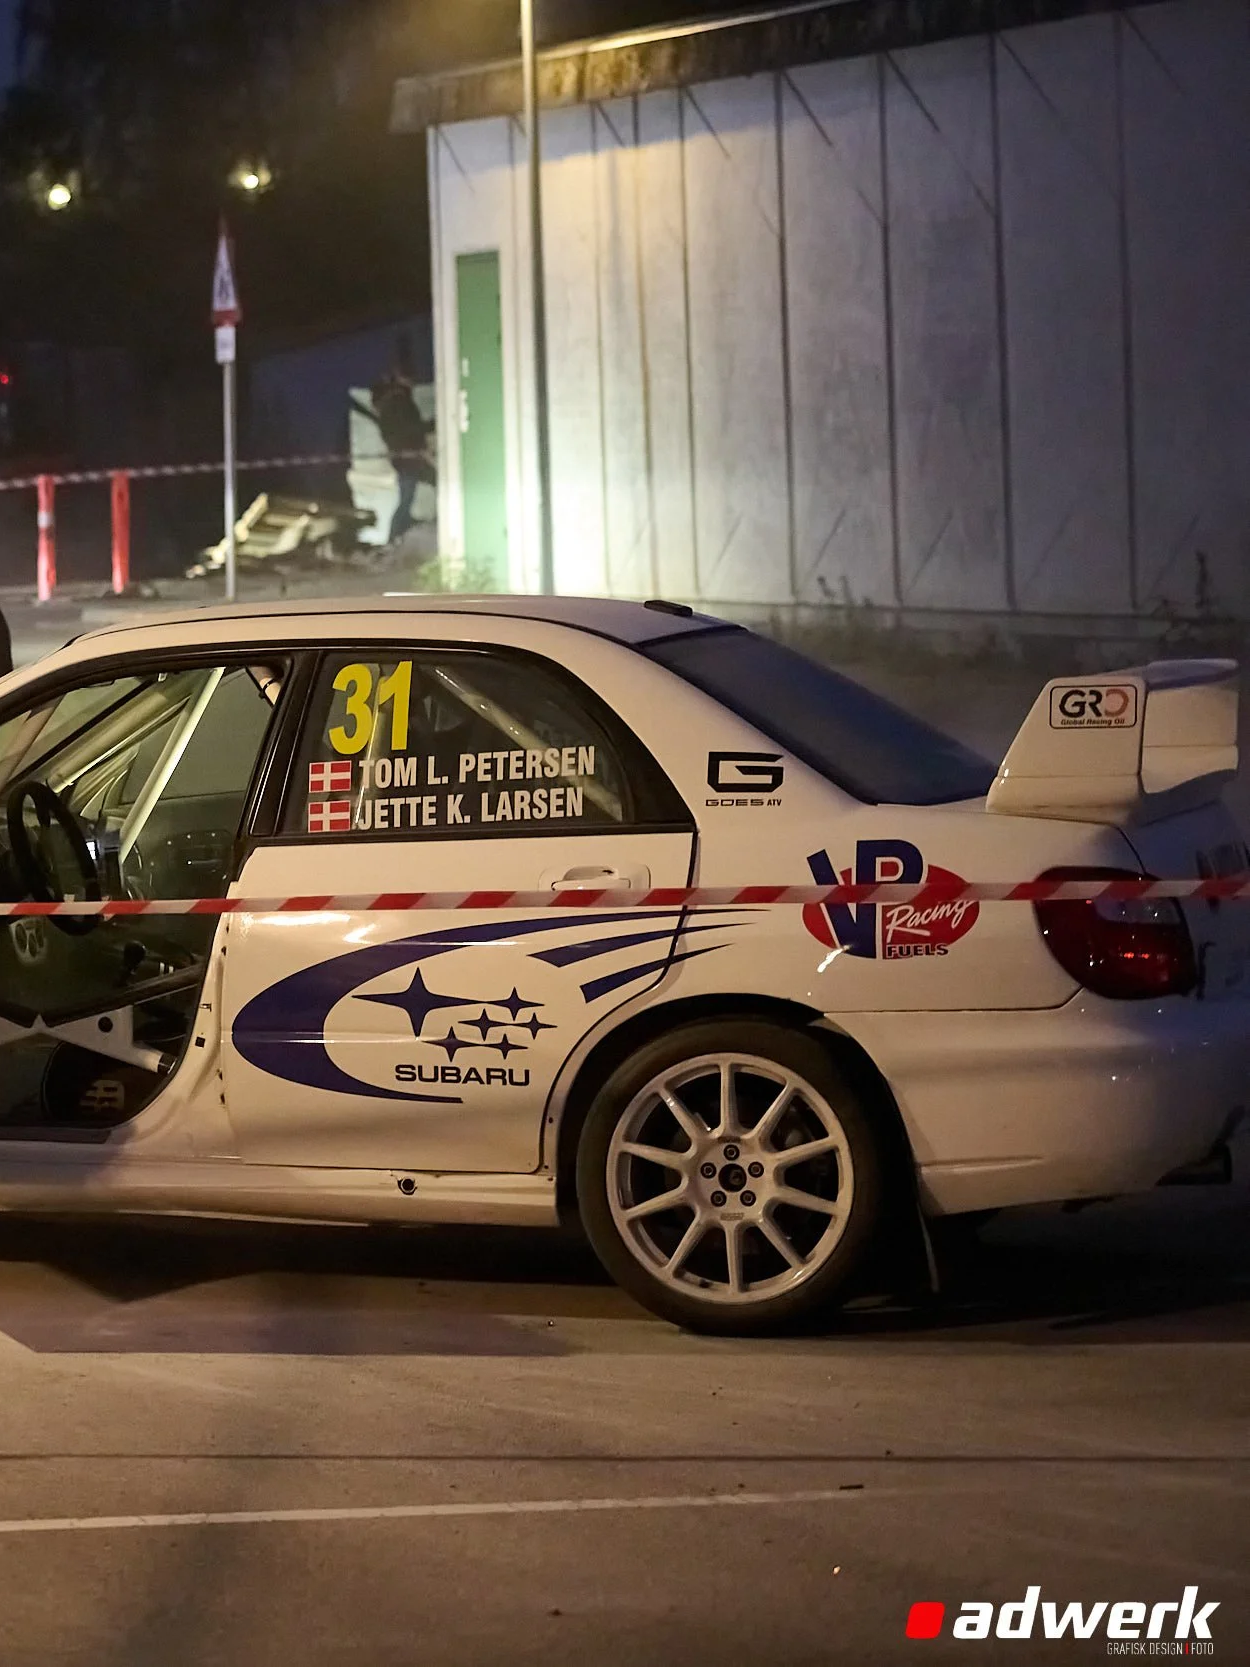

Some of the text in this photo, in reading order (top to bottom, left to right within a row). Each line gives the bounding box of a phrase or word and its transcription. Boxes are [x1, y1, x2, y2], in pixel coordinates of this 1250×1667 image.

[329, 660, 413, 755] 31
[1058, 688, 1130, 718] GRO
[1086, 718, 1112, 726] Racing
[359, 745, 595, 789] TOM L. PETERSEN
[357, 786, 583, 830] JETTE K. LARSEN
[705, 798, 782, 807] GOES ATV
[885, 898, 978, 944] Racing
[887, 943, 949, 959] FUELS
[395, 1064, 530, 1087] SUBARU
